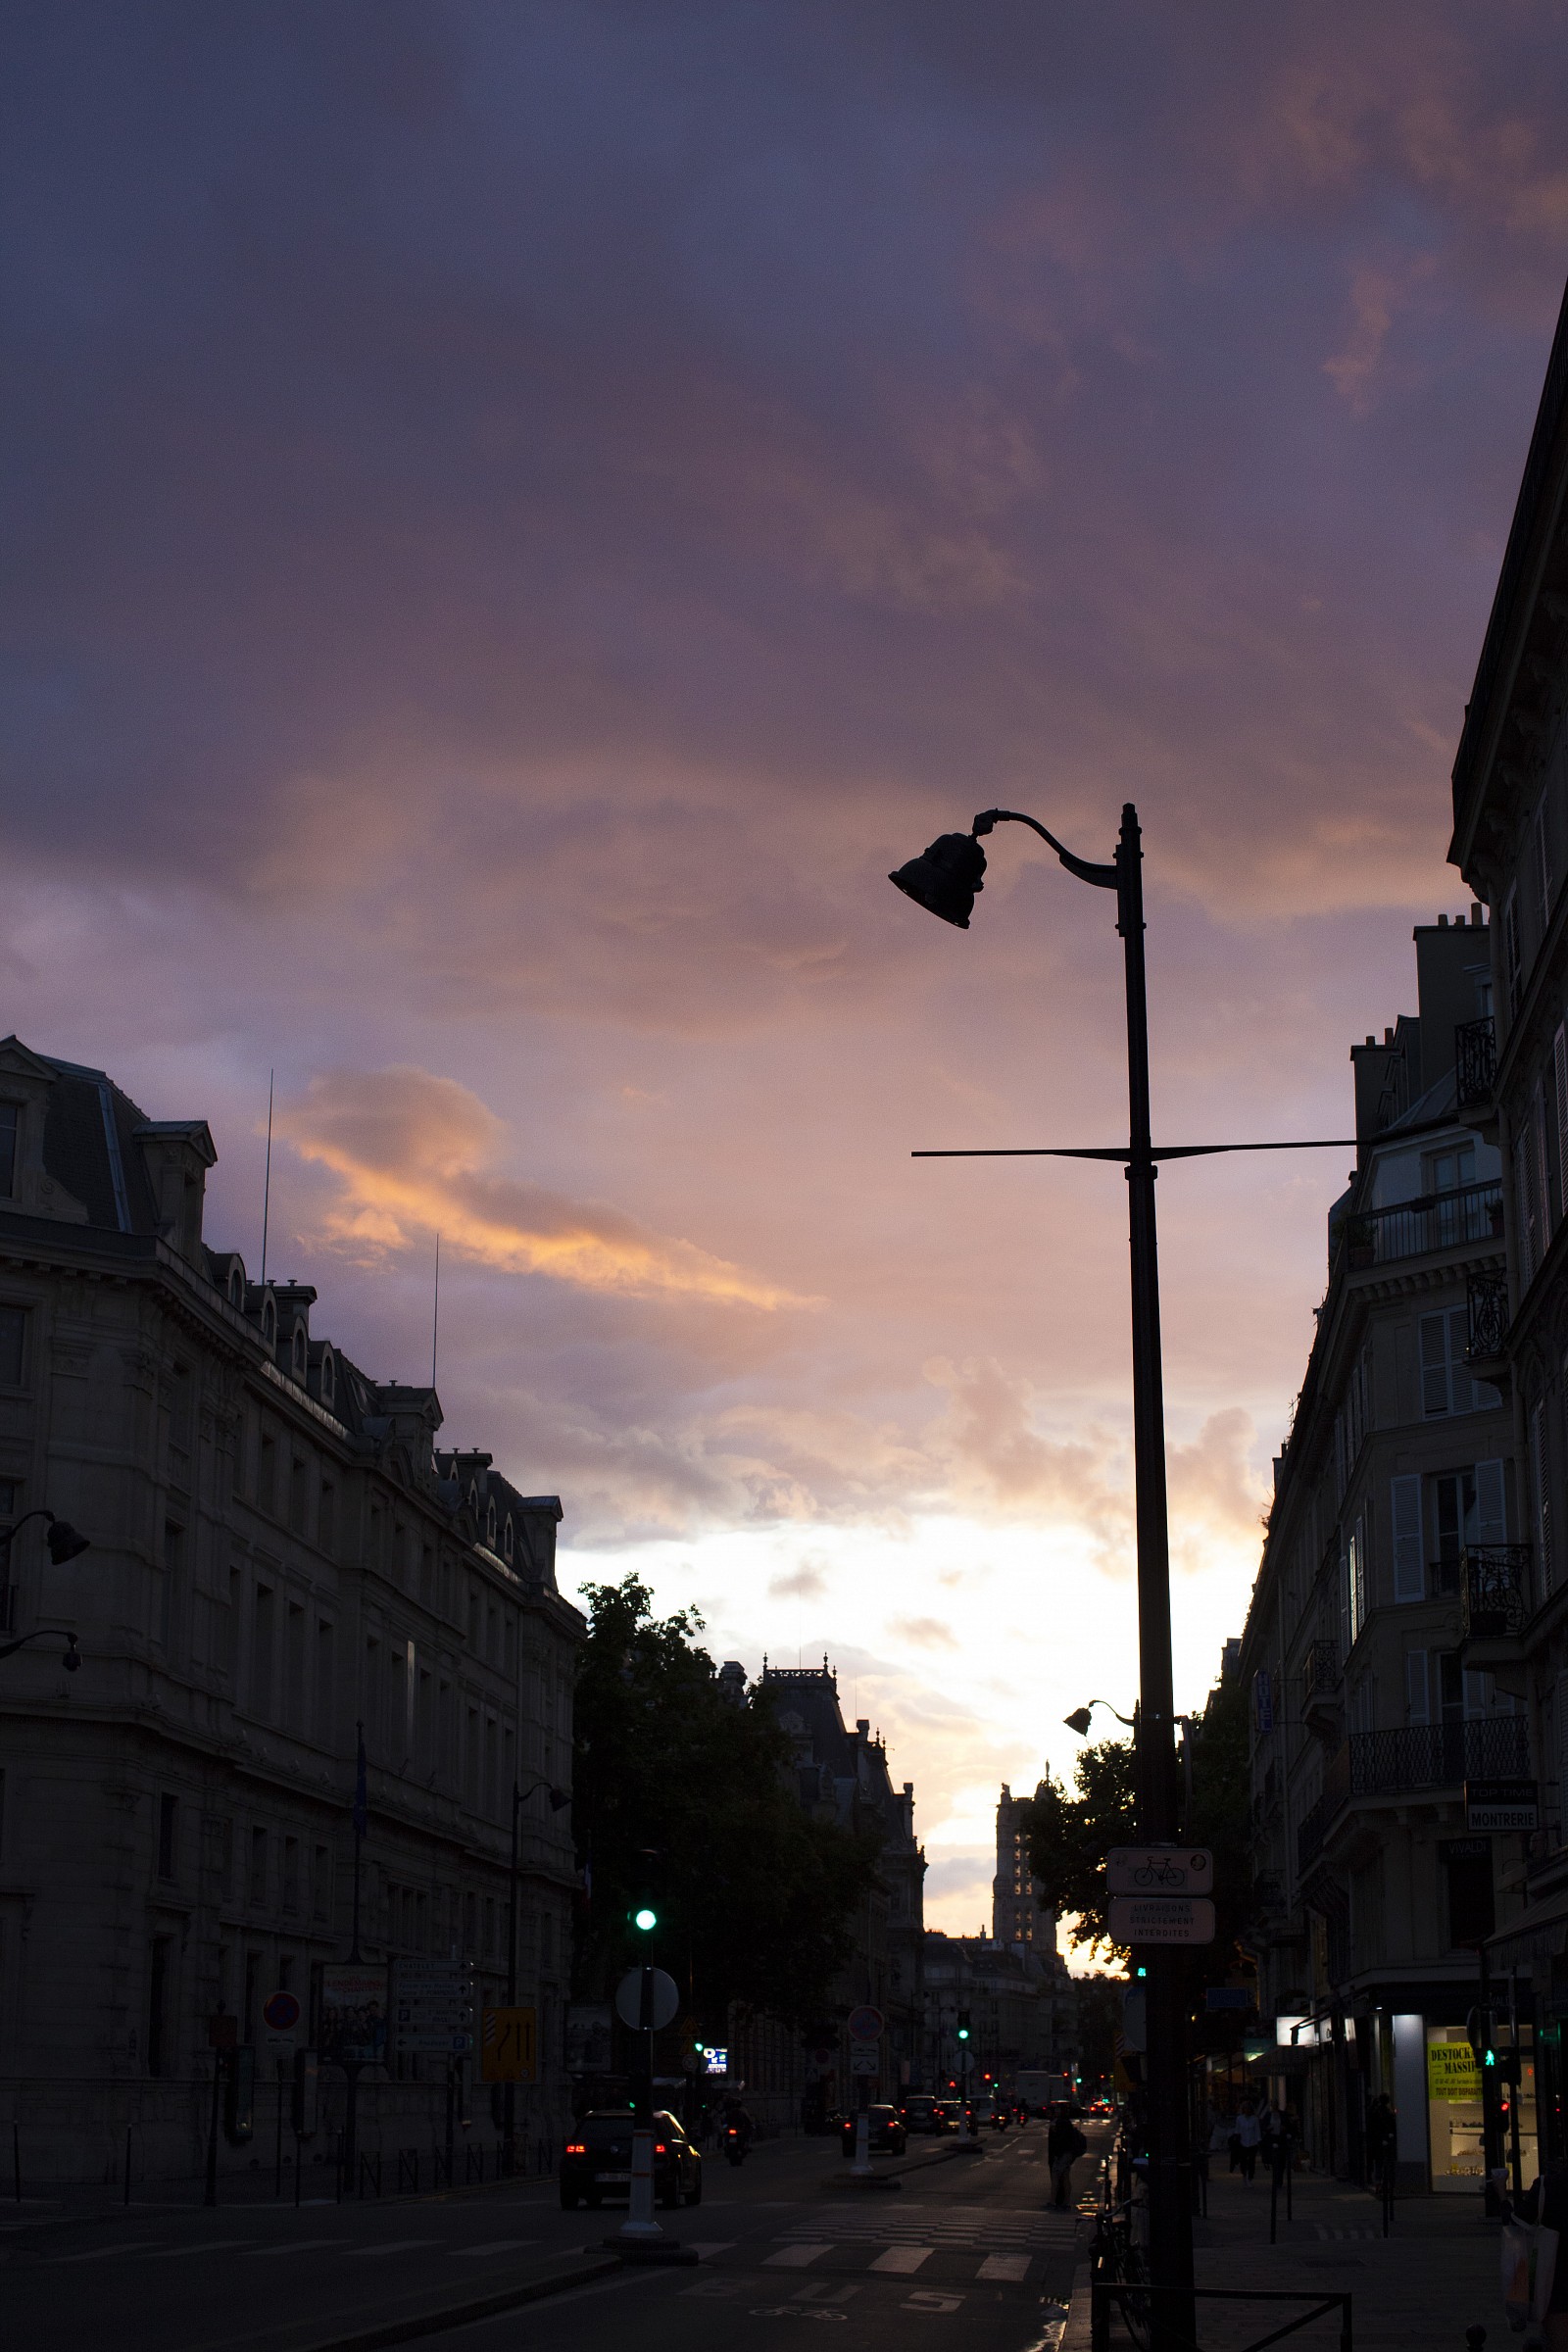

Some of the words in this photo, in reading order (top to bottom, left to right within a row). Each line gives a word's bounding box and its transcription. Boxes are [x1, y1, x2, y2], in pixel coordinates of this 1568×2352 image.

[1472, 1788, 1498, 1797] TOP
[1501, 1788, 1534, 1797] TIME
[1472, 1812, 1535, 1827] MONTRERIE
[1448, 1839, 1487, 1855] VIVALDI
[1134, 1904, 1191, 1913] LIVRAISONS
[1129, 1916, 1195, 1926] STRICTEMENT
[1134, 1929, 1190, 1937] INTERDITES
[1431, 2047, 1474, 2062] DESTOCK
